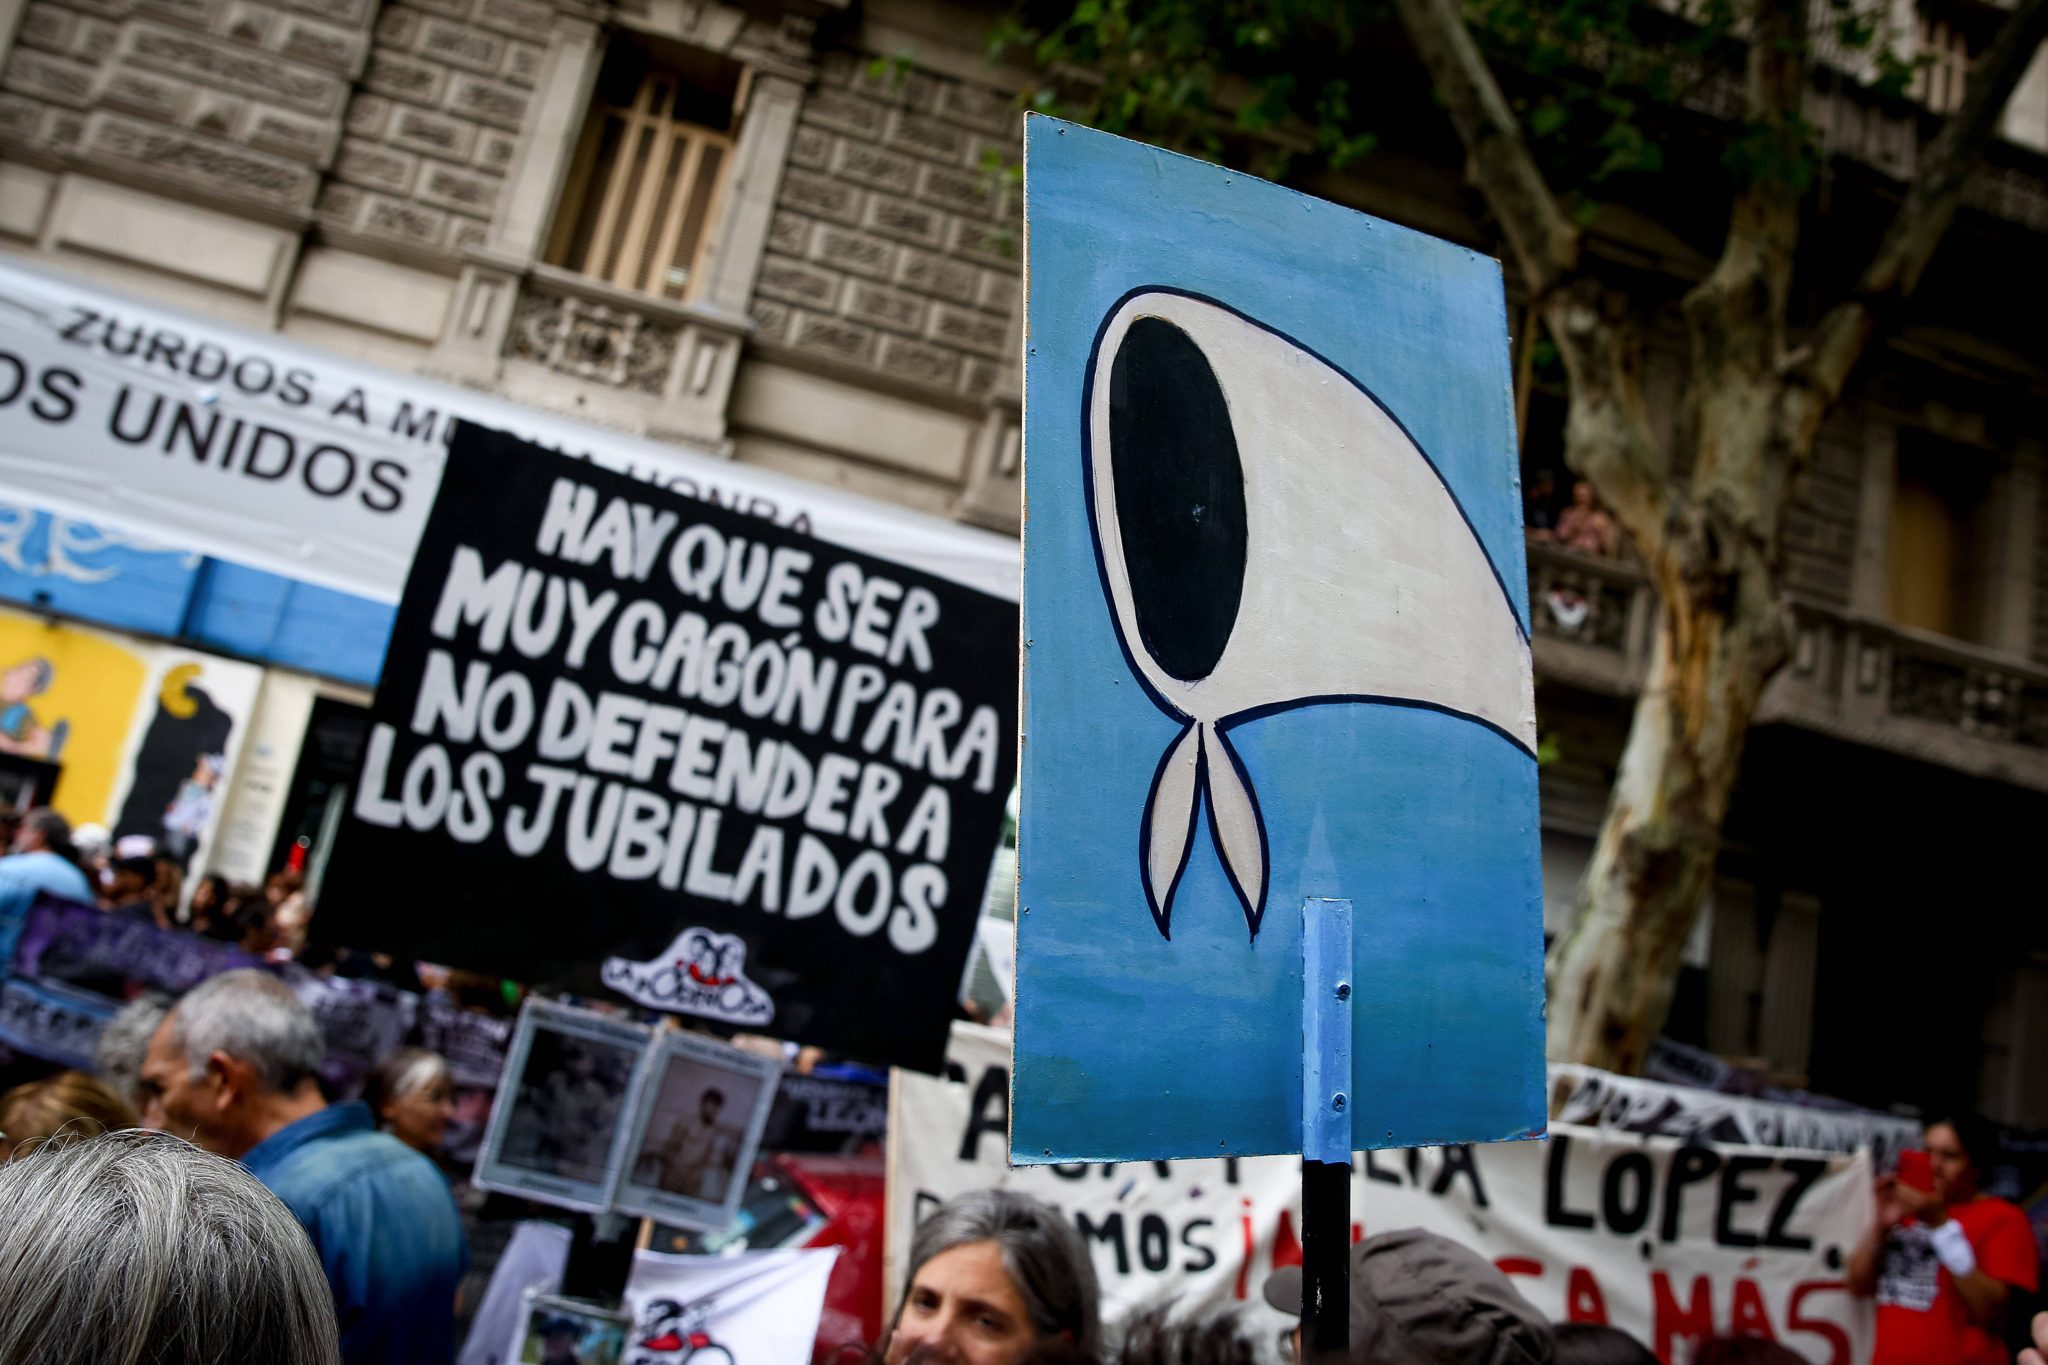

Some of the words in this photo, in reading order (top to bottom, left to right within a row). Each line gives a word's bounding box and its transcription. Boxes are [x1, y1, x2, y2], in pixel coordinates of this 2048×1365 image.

[60, 307, 315, 407] ZURDOS
[331, 389, 368, 425] A
[109, 385, 410, 516] UNIDOS
[432, 546, 618, 668] MUY
[610, 600, 837, 734] CAGÓN
[832, 664, 1001, 793] PARA
[536, 478, 678, 581] HAY
[669, 524, 813, 628] QUE
[815, 562, 940, 672] SER
[354, 724, 506, 843] LOS
[505, 764, 949, 954] JUBILADOS
[411, 650, 536, 751] NO
[538, 677, 902, 848] DEFENDER
[897, 785, 951, 862] A
